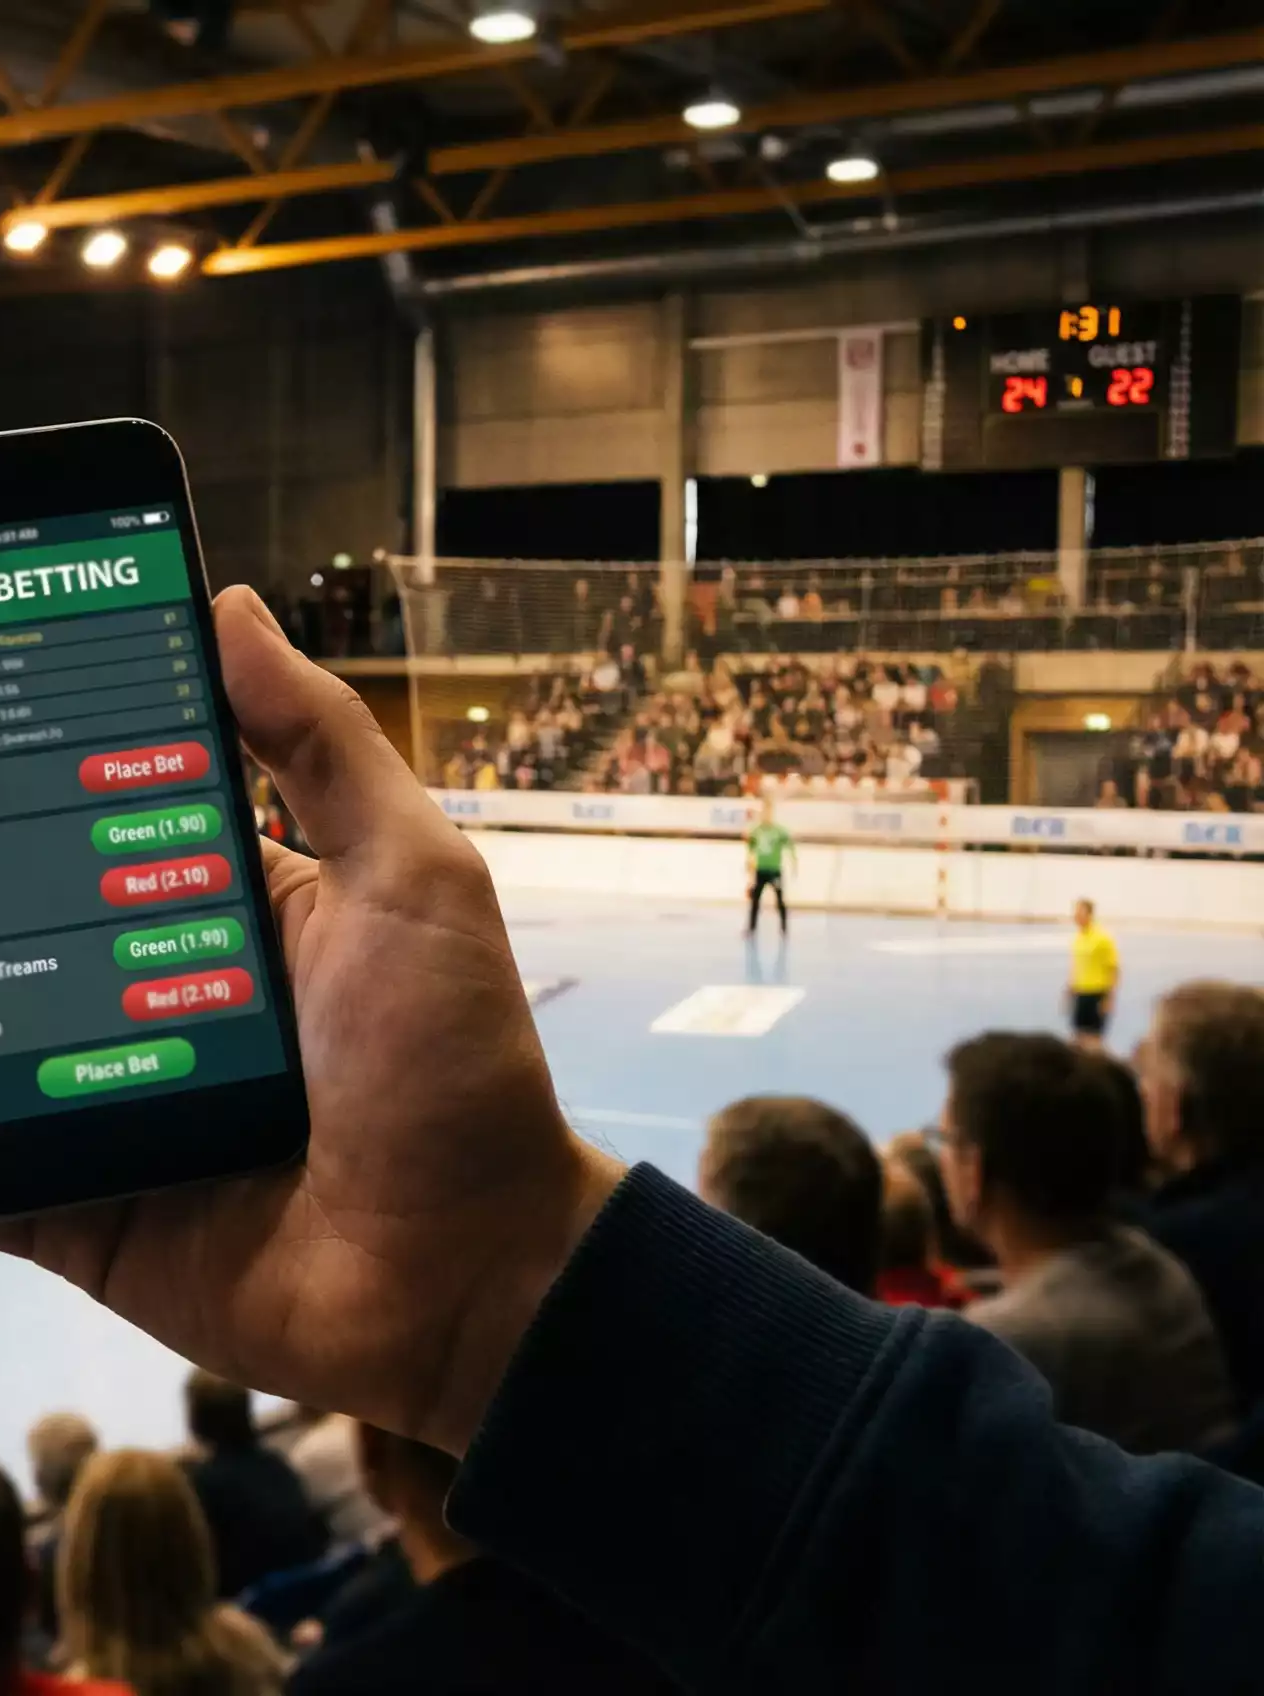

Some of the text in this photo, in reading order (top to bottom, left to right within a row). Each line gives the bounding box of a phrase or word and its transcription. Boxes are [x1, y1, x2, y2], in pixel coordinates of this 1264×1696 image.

[1088, 341, 1156, 368] GUEST
[1002, 376, 1047, 413] 24
[1107, 367, 1154, 406] 22
[104, 753, 185, 781] Place Bet
[108, 813, 207, 844] Green (1.90)
[125, 865, 209, 894] Red (2.10)
[130, 927, 228, 958] Green (1.90)
[147, 979, 231, 1010] Red (2.10)
[75, 1054, 159, 1083] Place Bet
